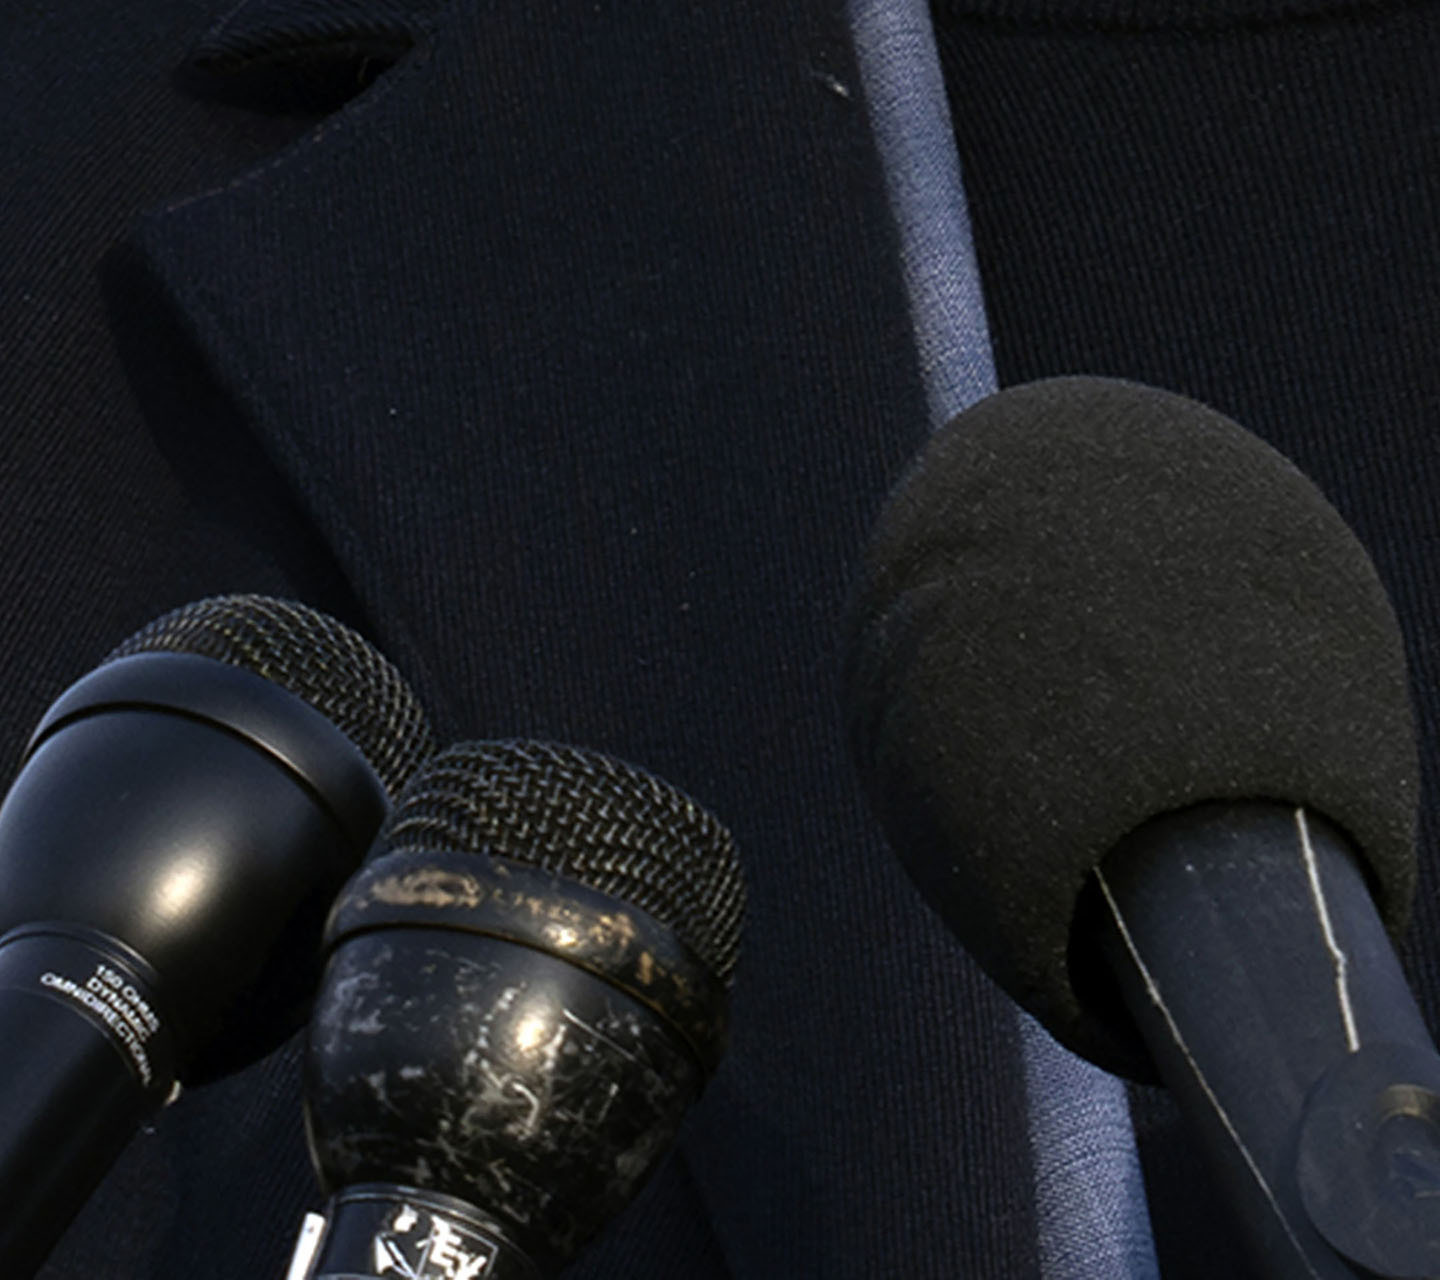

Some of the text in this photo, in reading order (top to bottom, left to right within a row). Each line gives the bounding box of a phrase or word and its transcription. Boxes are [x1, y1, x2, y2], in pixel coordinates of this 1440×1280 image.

[86, 977, 151, 1042] DYNAMIC
[97, 964, 159, 1033] 150 OHMS
